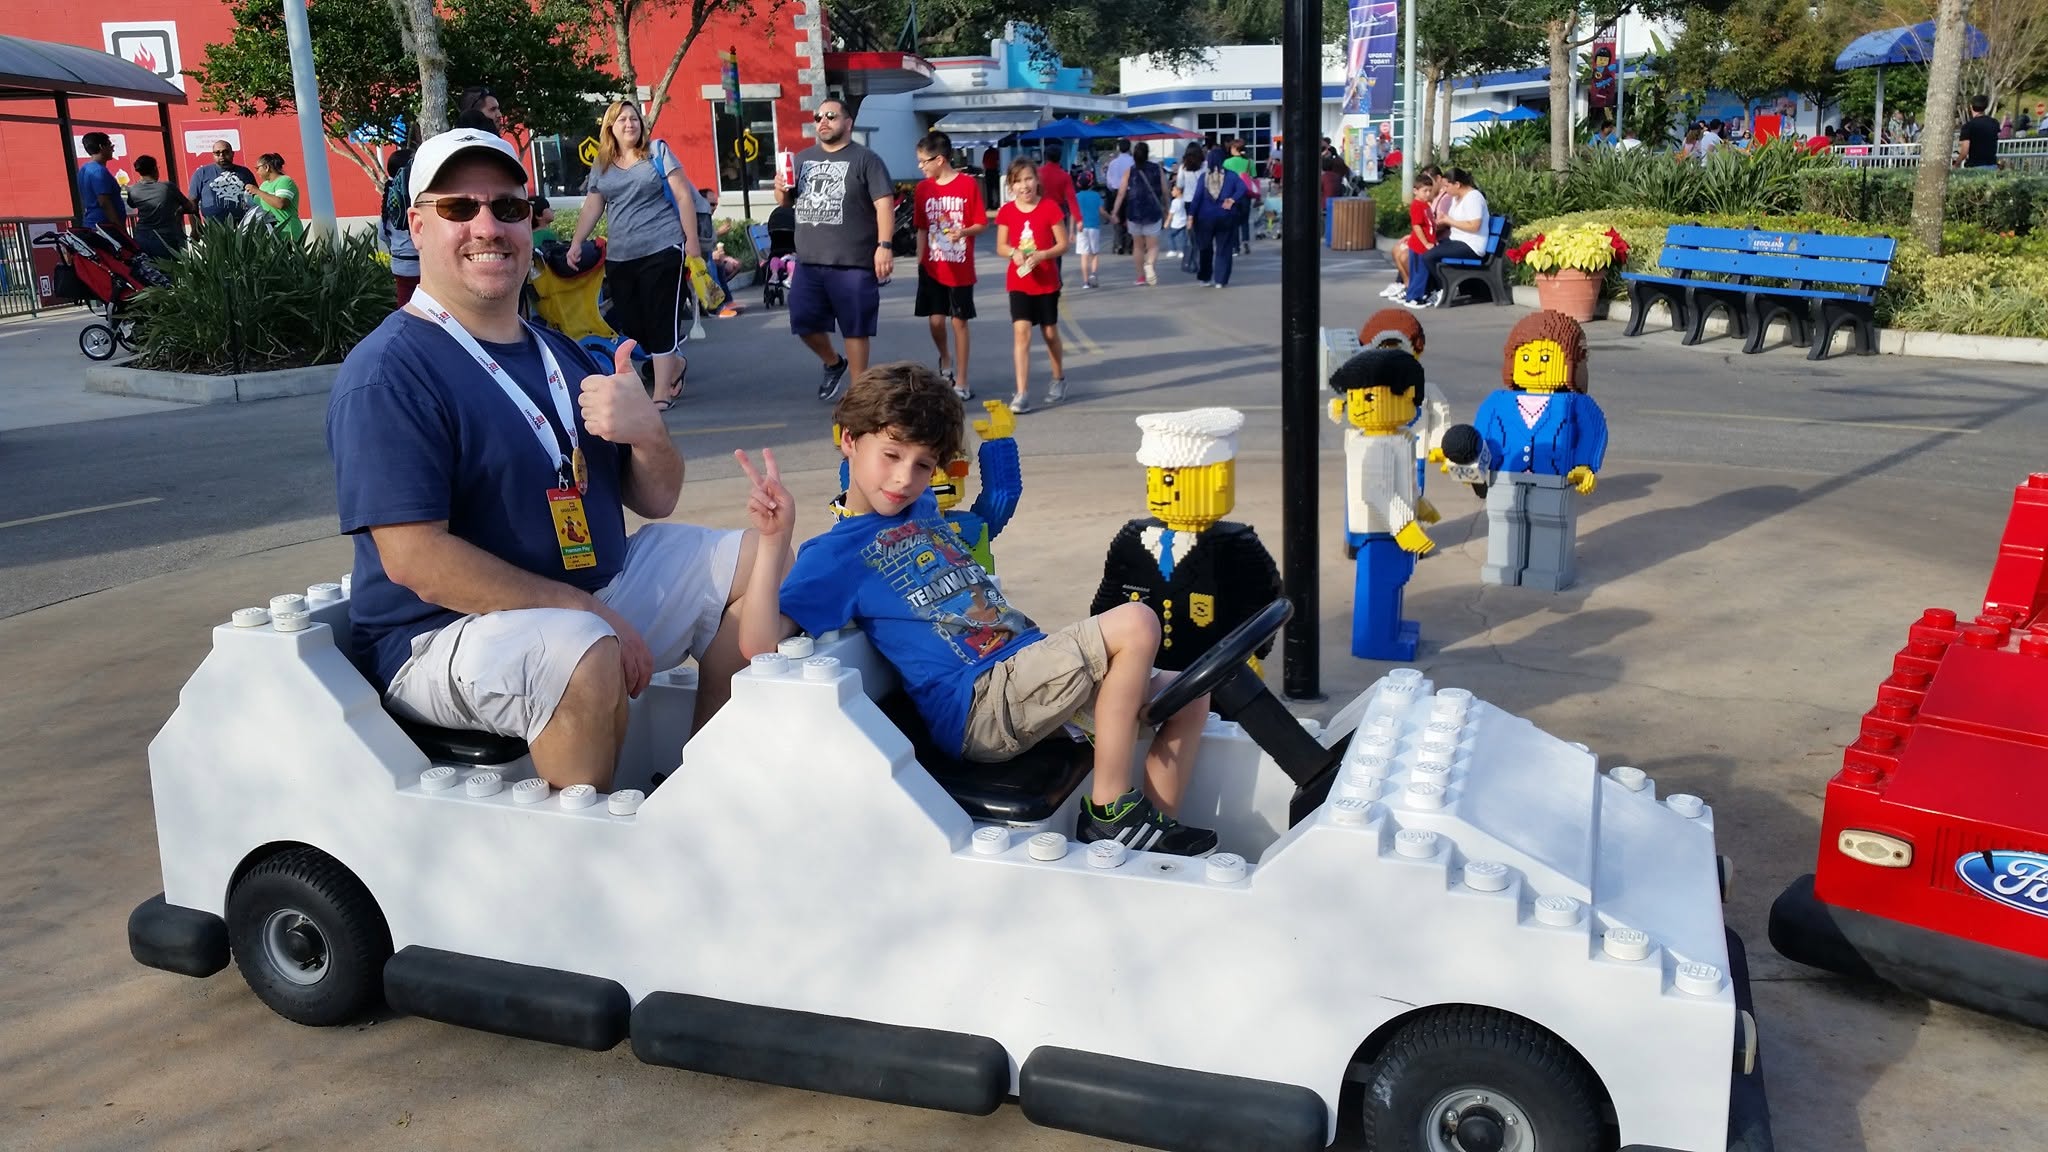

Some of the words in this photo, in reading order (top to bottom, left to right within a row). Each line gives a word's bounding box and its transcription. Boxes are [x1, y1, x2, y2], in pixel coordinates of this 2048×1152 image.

[1212, 89, 1252, 101] ENTRANCE
[1753, 239, 1784, 248] LEGOLAND
[906, 565, 988, 608] TEAMWOR
